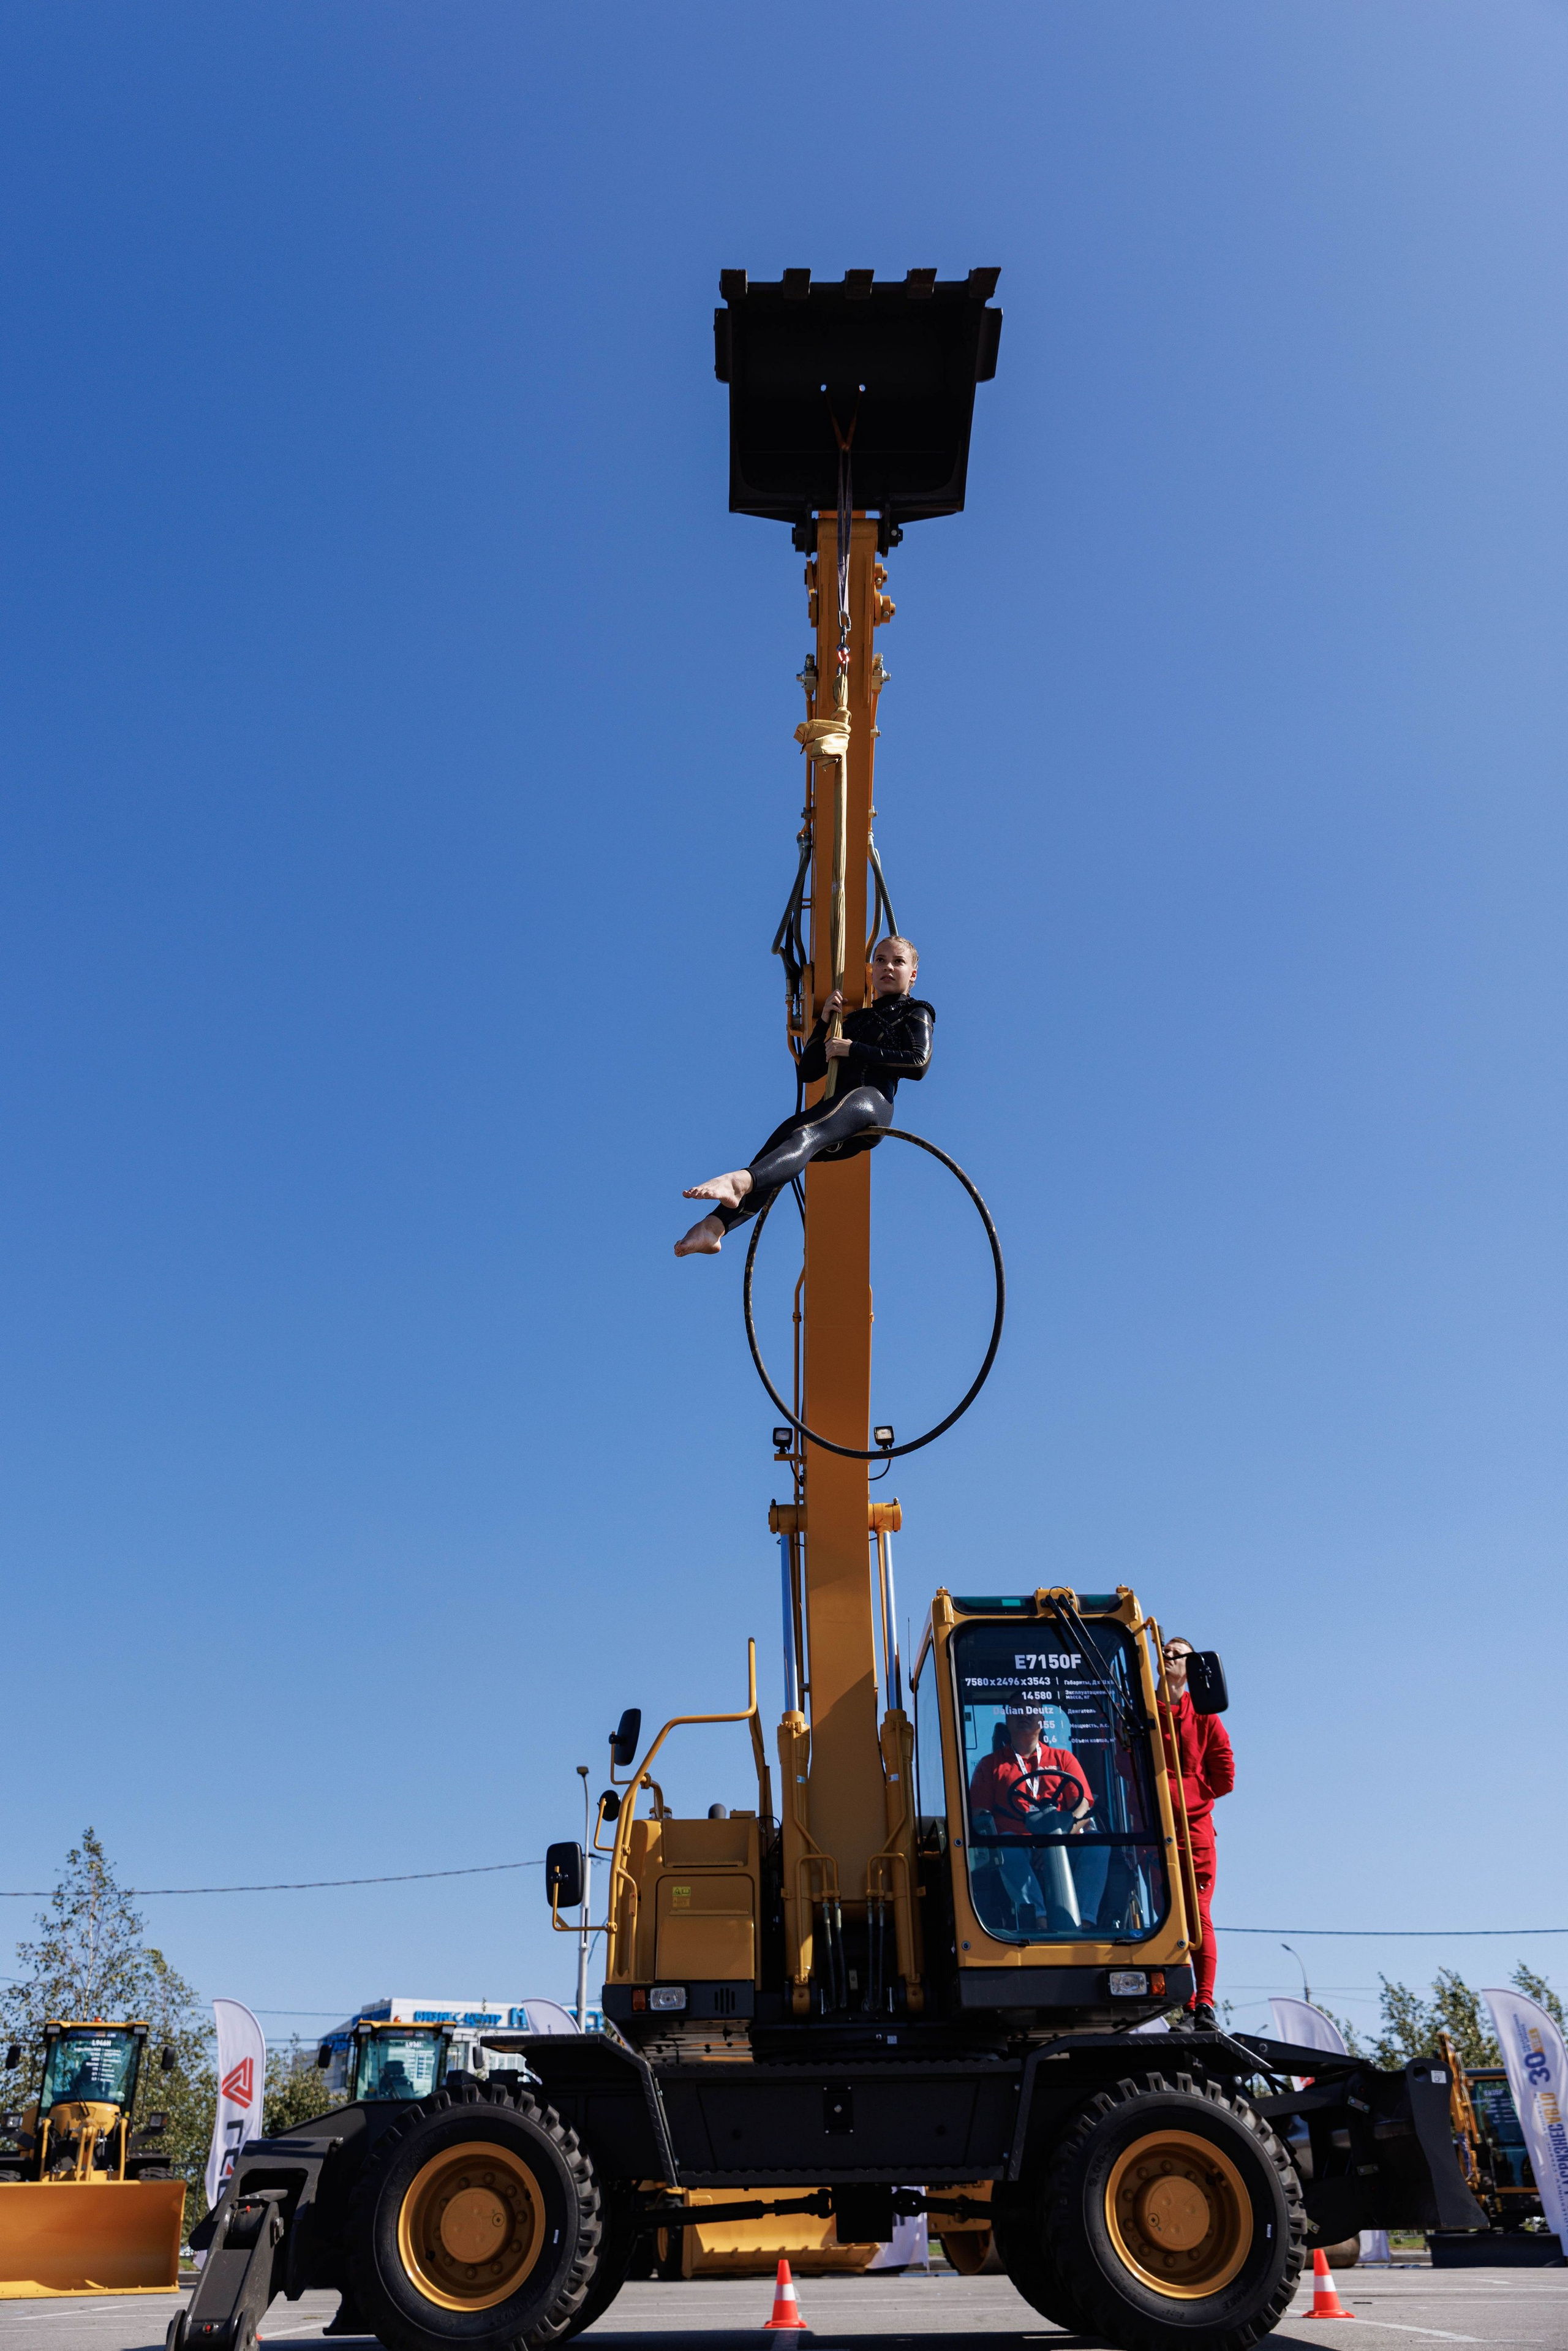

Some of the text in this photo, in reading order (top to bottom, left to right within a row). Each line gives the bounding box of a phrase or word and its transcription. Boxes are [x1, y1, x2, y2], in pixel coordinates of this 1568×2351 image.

[1014, 1654, 1082, 1669] E7150F
[993, 1706, 1023, 1715] Dalian
[1026, 1706, 1054, 1715] Deutz
[1038, 1720, 1055, 1729] 155
[1043, 1735, 1057, 1744] 0,6
